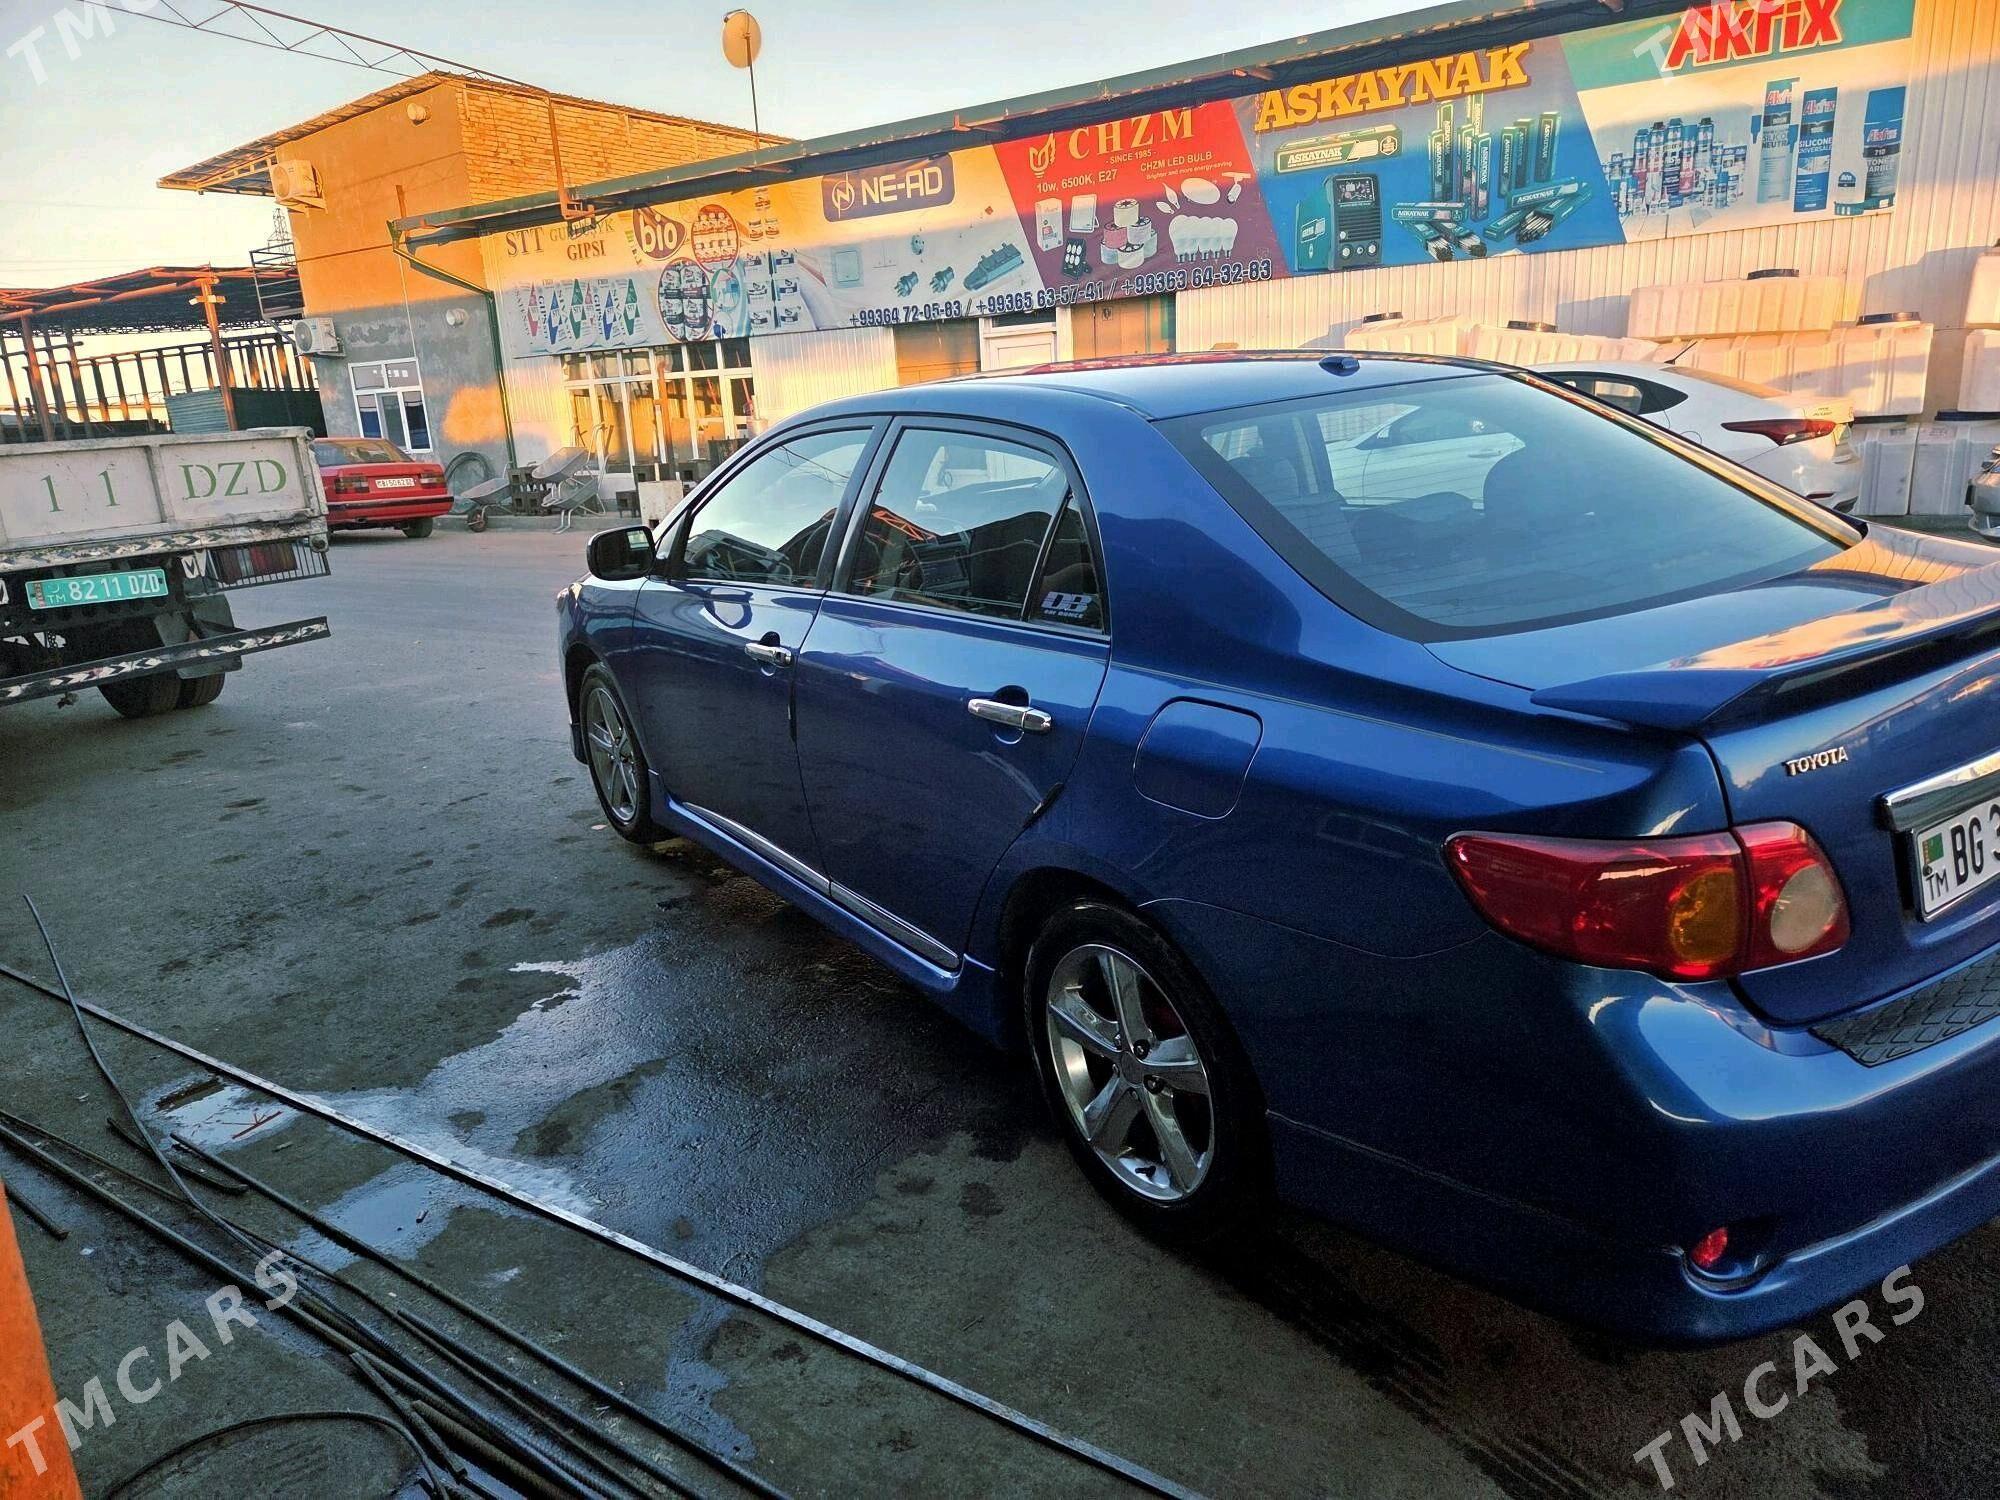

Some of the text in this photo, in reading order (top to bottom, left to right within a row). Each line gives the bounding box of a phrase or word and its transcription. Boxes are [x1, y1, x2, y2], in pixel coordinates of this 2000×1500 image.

[1254, 42, 1532, 132] ASKAYNAK
[1068, 108, 1195, 159] CHZM
[1110, 149, 1152, 164] SINCE 1985
[1140, 151, 1212, 172] CHZM LED BULB
[1287, 147, 1343, 164] ASKAYNAK
[861, 166, 943, 206] NE-AD
[1037, 168, 1118, 193] 10w, 6500K, E27
[506, 227, 545, 257] STT
[640, 212, 678, 253] bio
[567, 239, 607, 261] GIPSI
[850, 306, 899, 327] +99364
[903, 300, 962, 322] 72-05-83
[976, 290, 1033, 315] +99365
[1037, 280, 1104, 308] 63-57-41
[1121, 269, 1188, 296] +99363
[1191, 259, 1272, 288] 64-32-83
[179, 459, 287, 501] DZD
[47, 593, 66, 604] TM
[128, 574, 160, 594] DZD
[1786, 747, 1848, 776] TOYOTA
[1950, 816, 1984, 886] BG
[1925, 868, 1949, 901] TM
